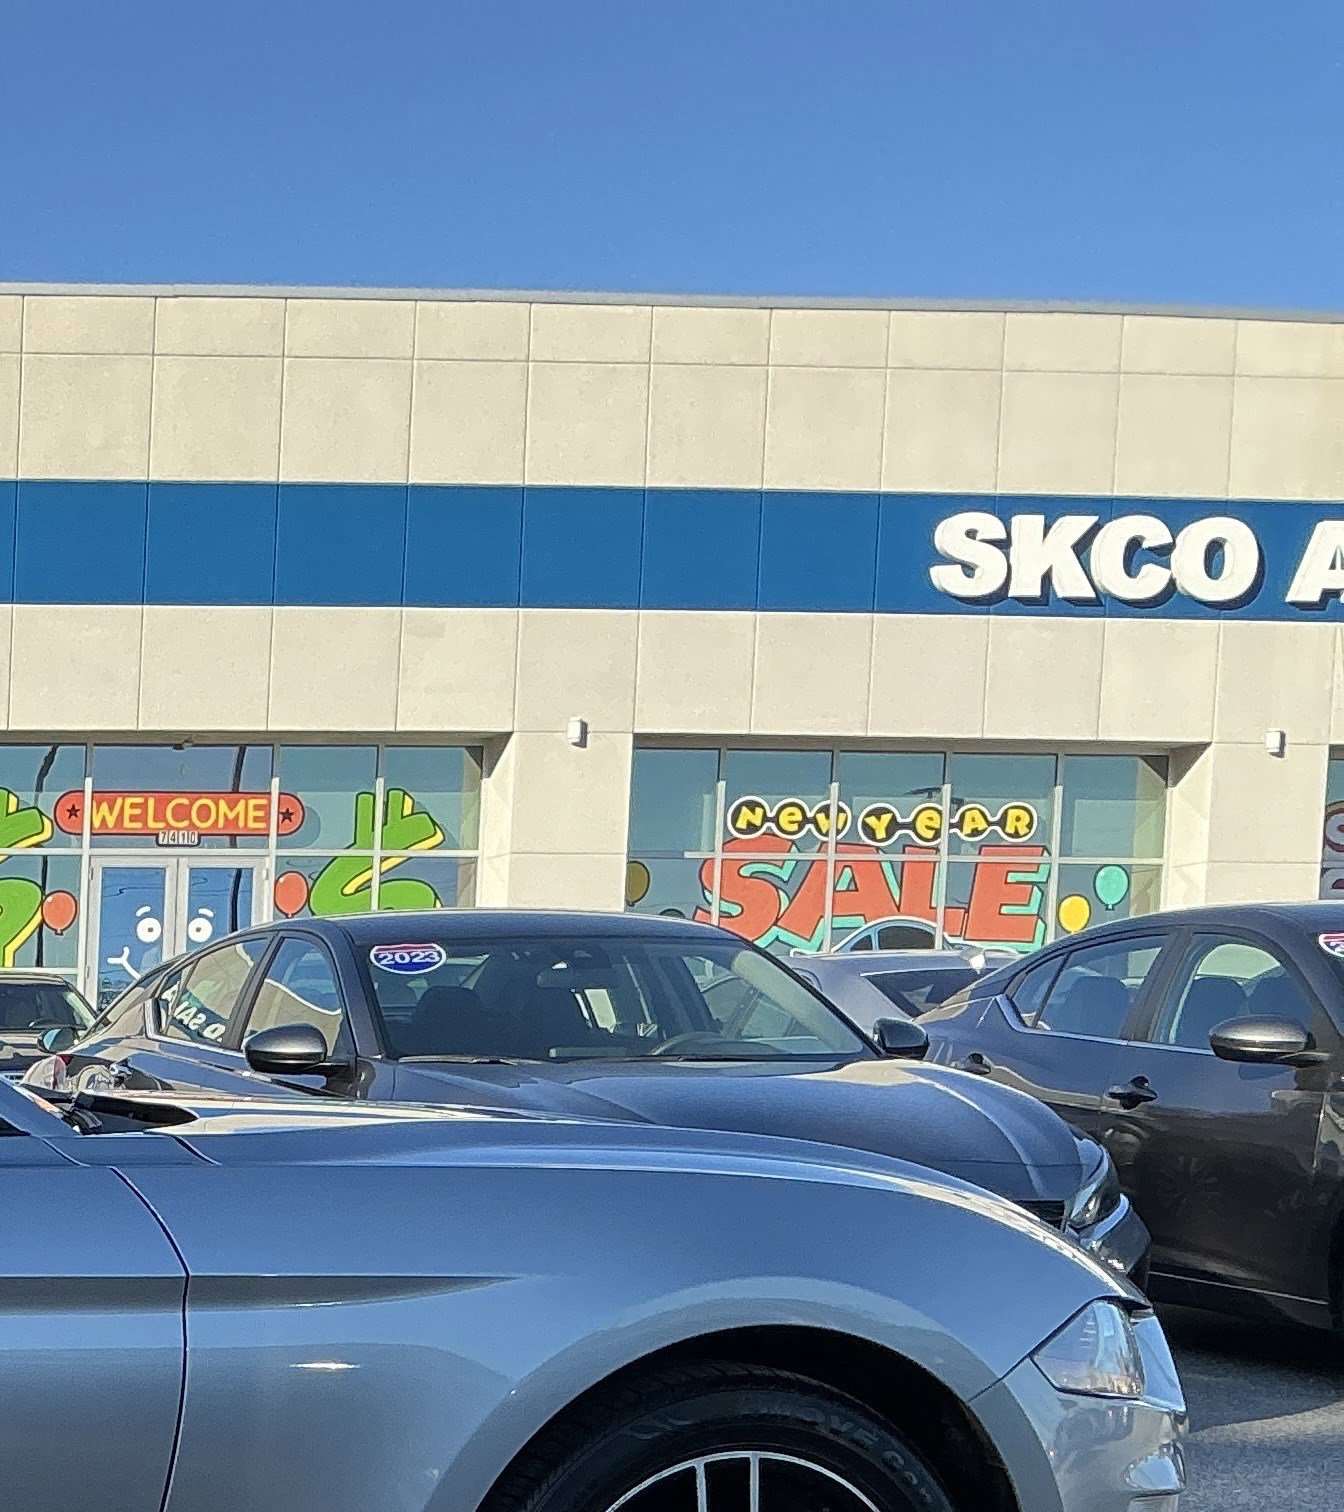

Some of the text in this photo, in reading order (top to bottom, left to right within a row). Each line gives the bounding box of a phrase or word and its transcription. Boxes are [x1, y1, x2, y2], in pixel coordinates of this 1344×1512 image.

[929, 511, 1261, 603] SKCO
[91, 796, 269, 830] WELCOME
[160, 831, 197, 845] 7410
[693, 834, 1050, 944] SALE
[378, 950, 441, 965] 2023
